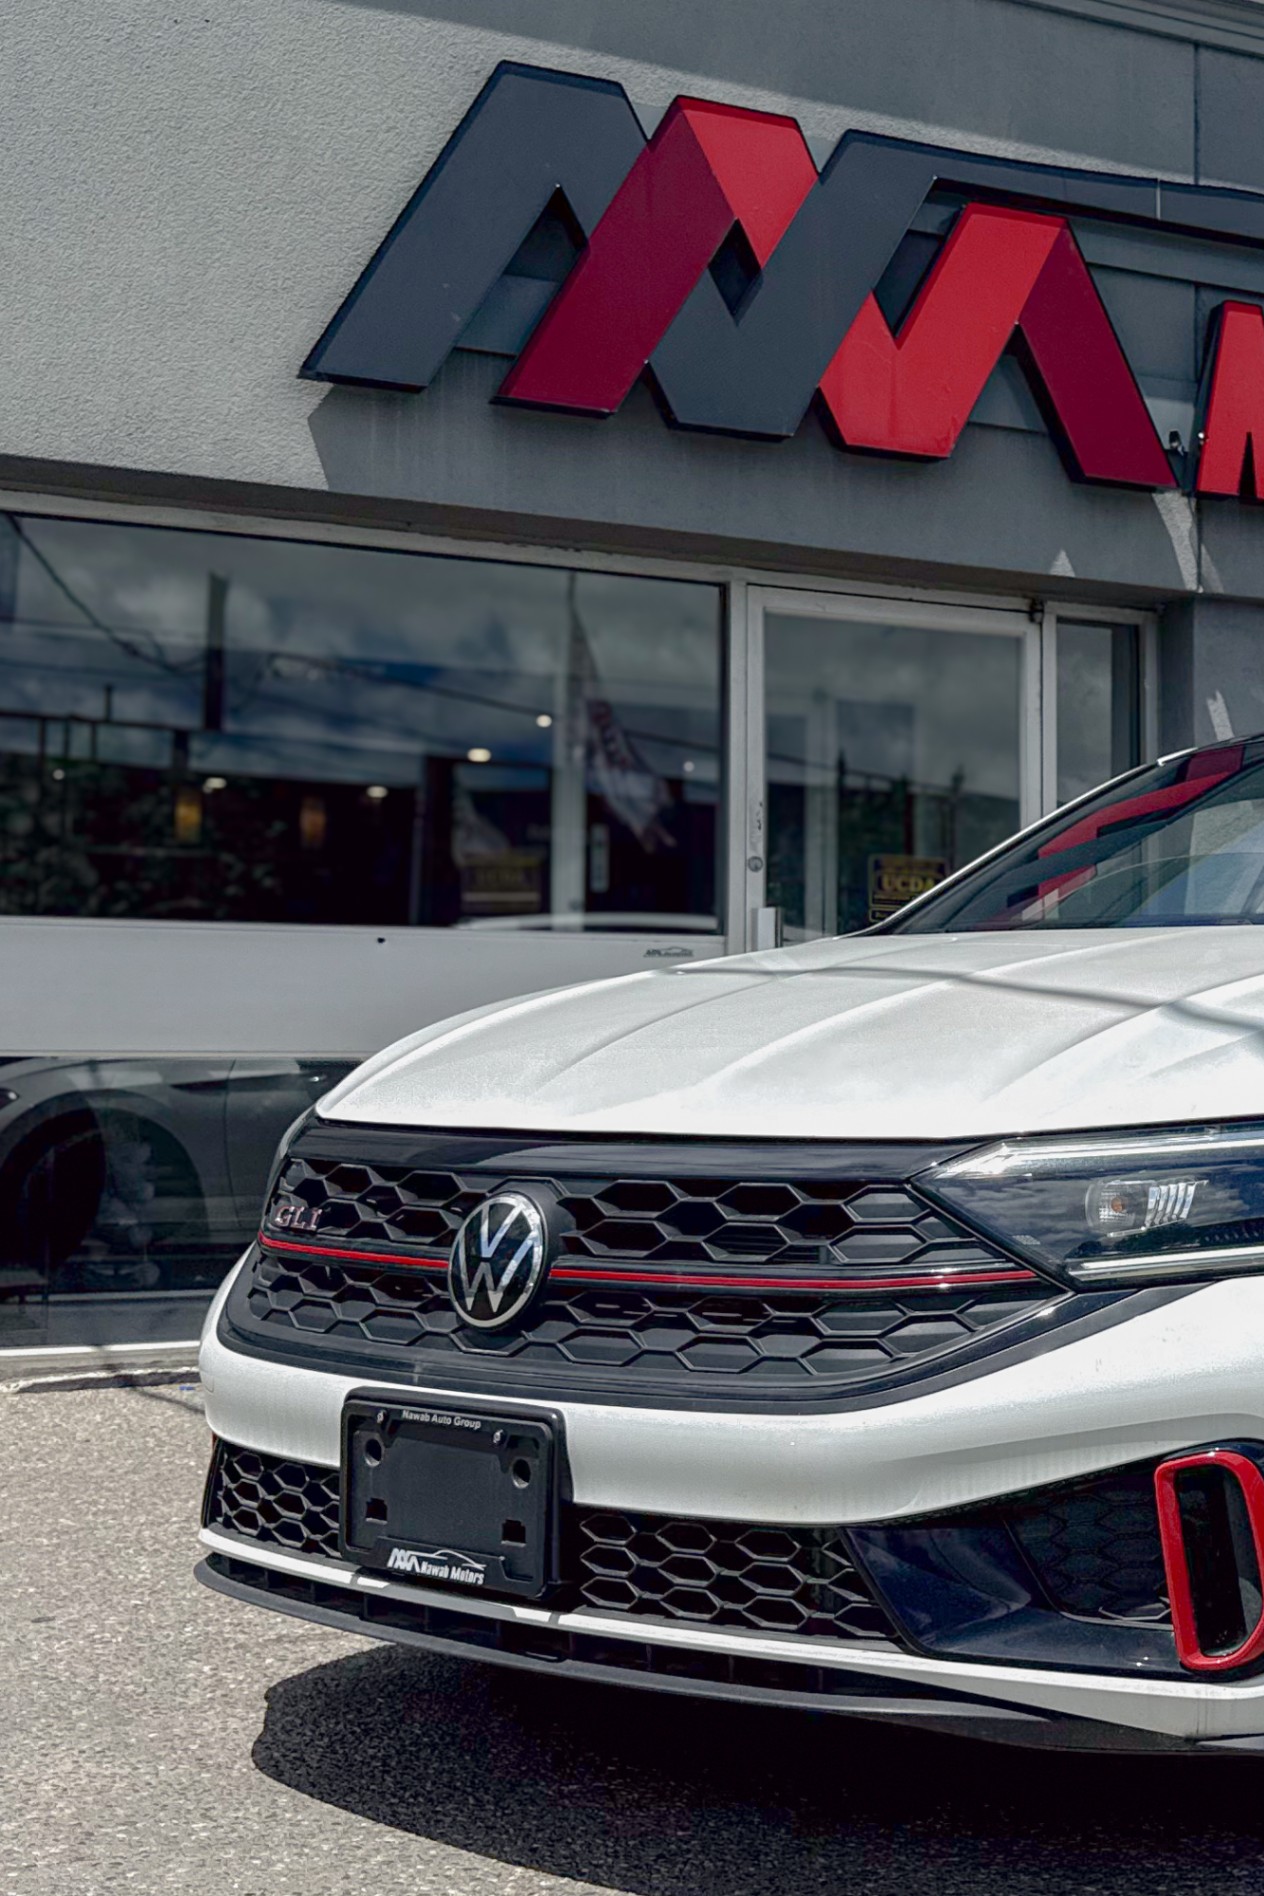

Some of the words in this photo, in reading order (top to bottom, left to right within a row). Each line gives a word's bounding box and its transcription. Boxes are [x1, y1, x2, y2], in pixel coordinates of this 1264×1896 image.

[274, 1205, 322, 1231] GLI
[401, 1409, 430, 1422] Nawab
[431, 1414, 452, 1425] Auto
[453, 1416, 482, 1430] Group
[421, 1560, 450, 1579] Nawab
[449, 1565, 486, 1586] Motors
